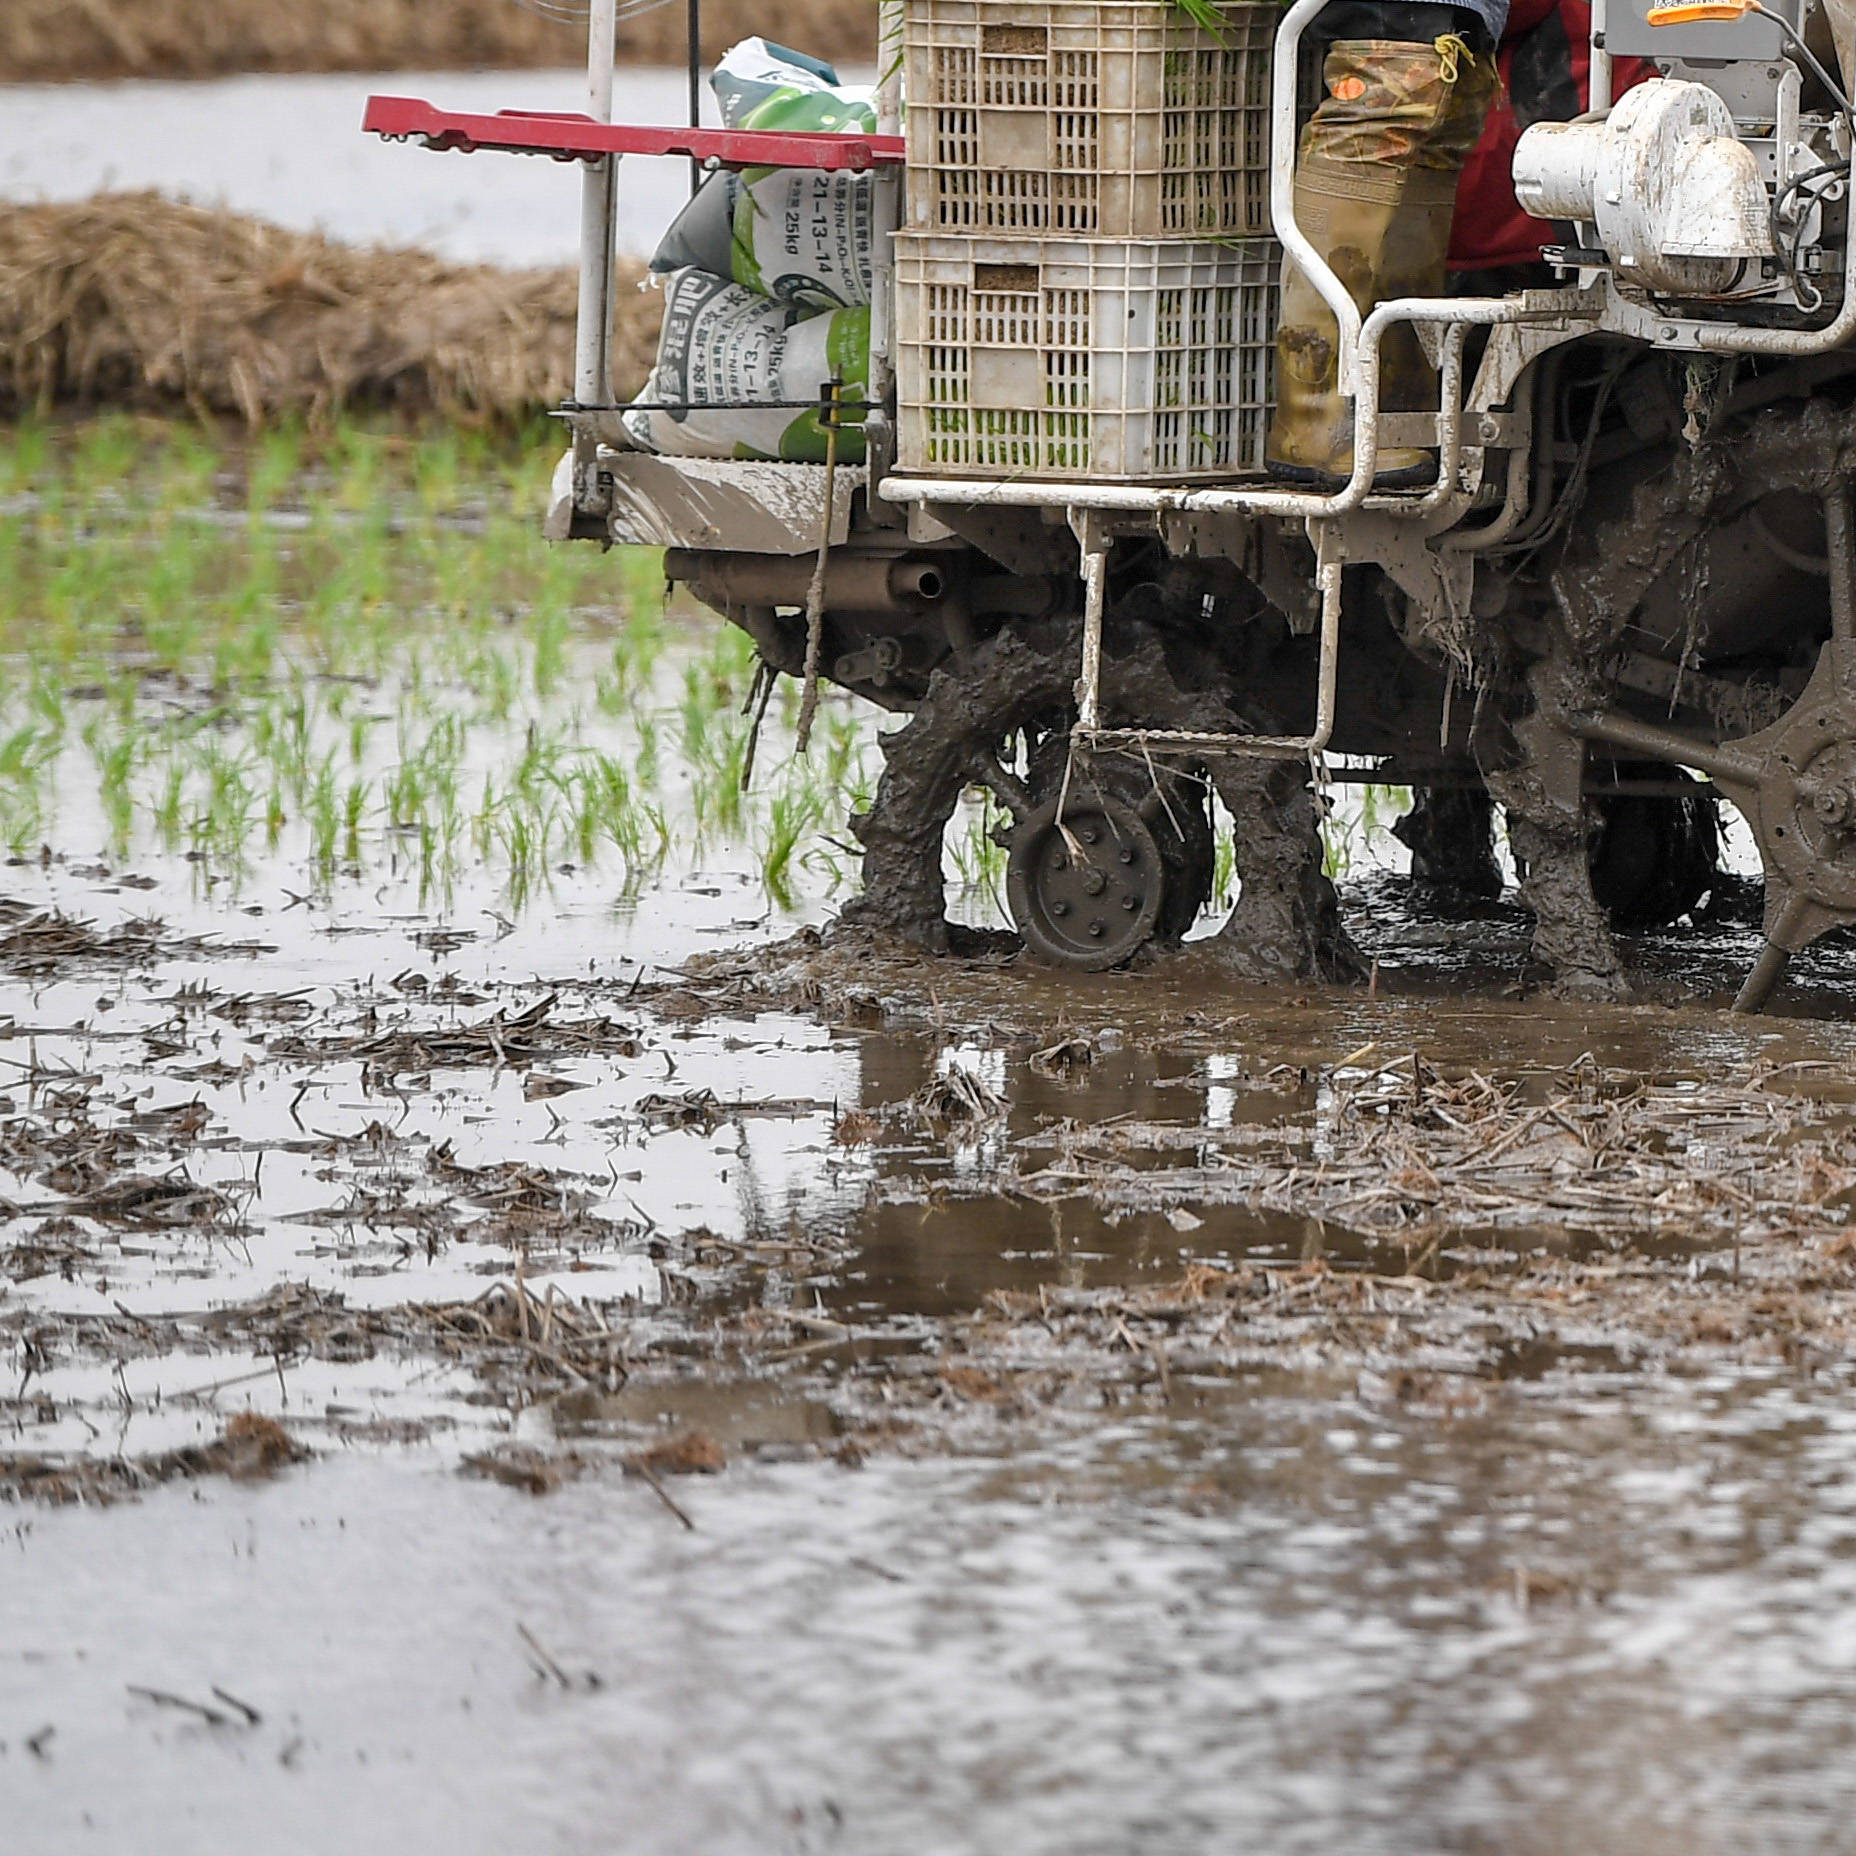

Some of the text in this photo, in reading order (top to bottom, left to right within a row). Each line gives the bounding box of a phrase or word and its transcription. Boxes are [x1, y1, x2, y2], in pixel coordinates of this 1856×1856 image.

[784, 211, 800, 255] 25kg
[811, 176, 833, 274] 21-13-14
[742, 323, 776, 403] 1-13-14
